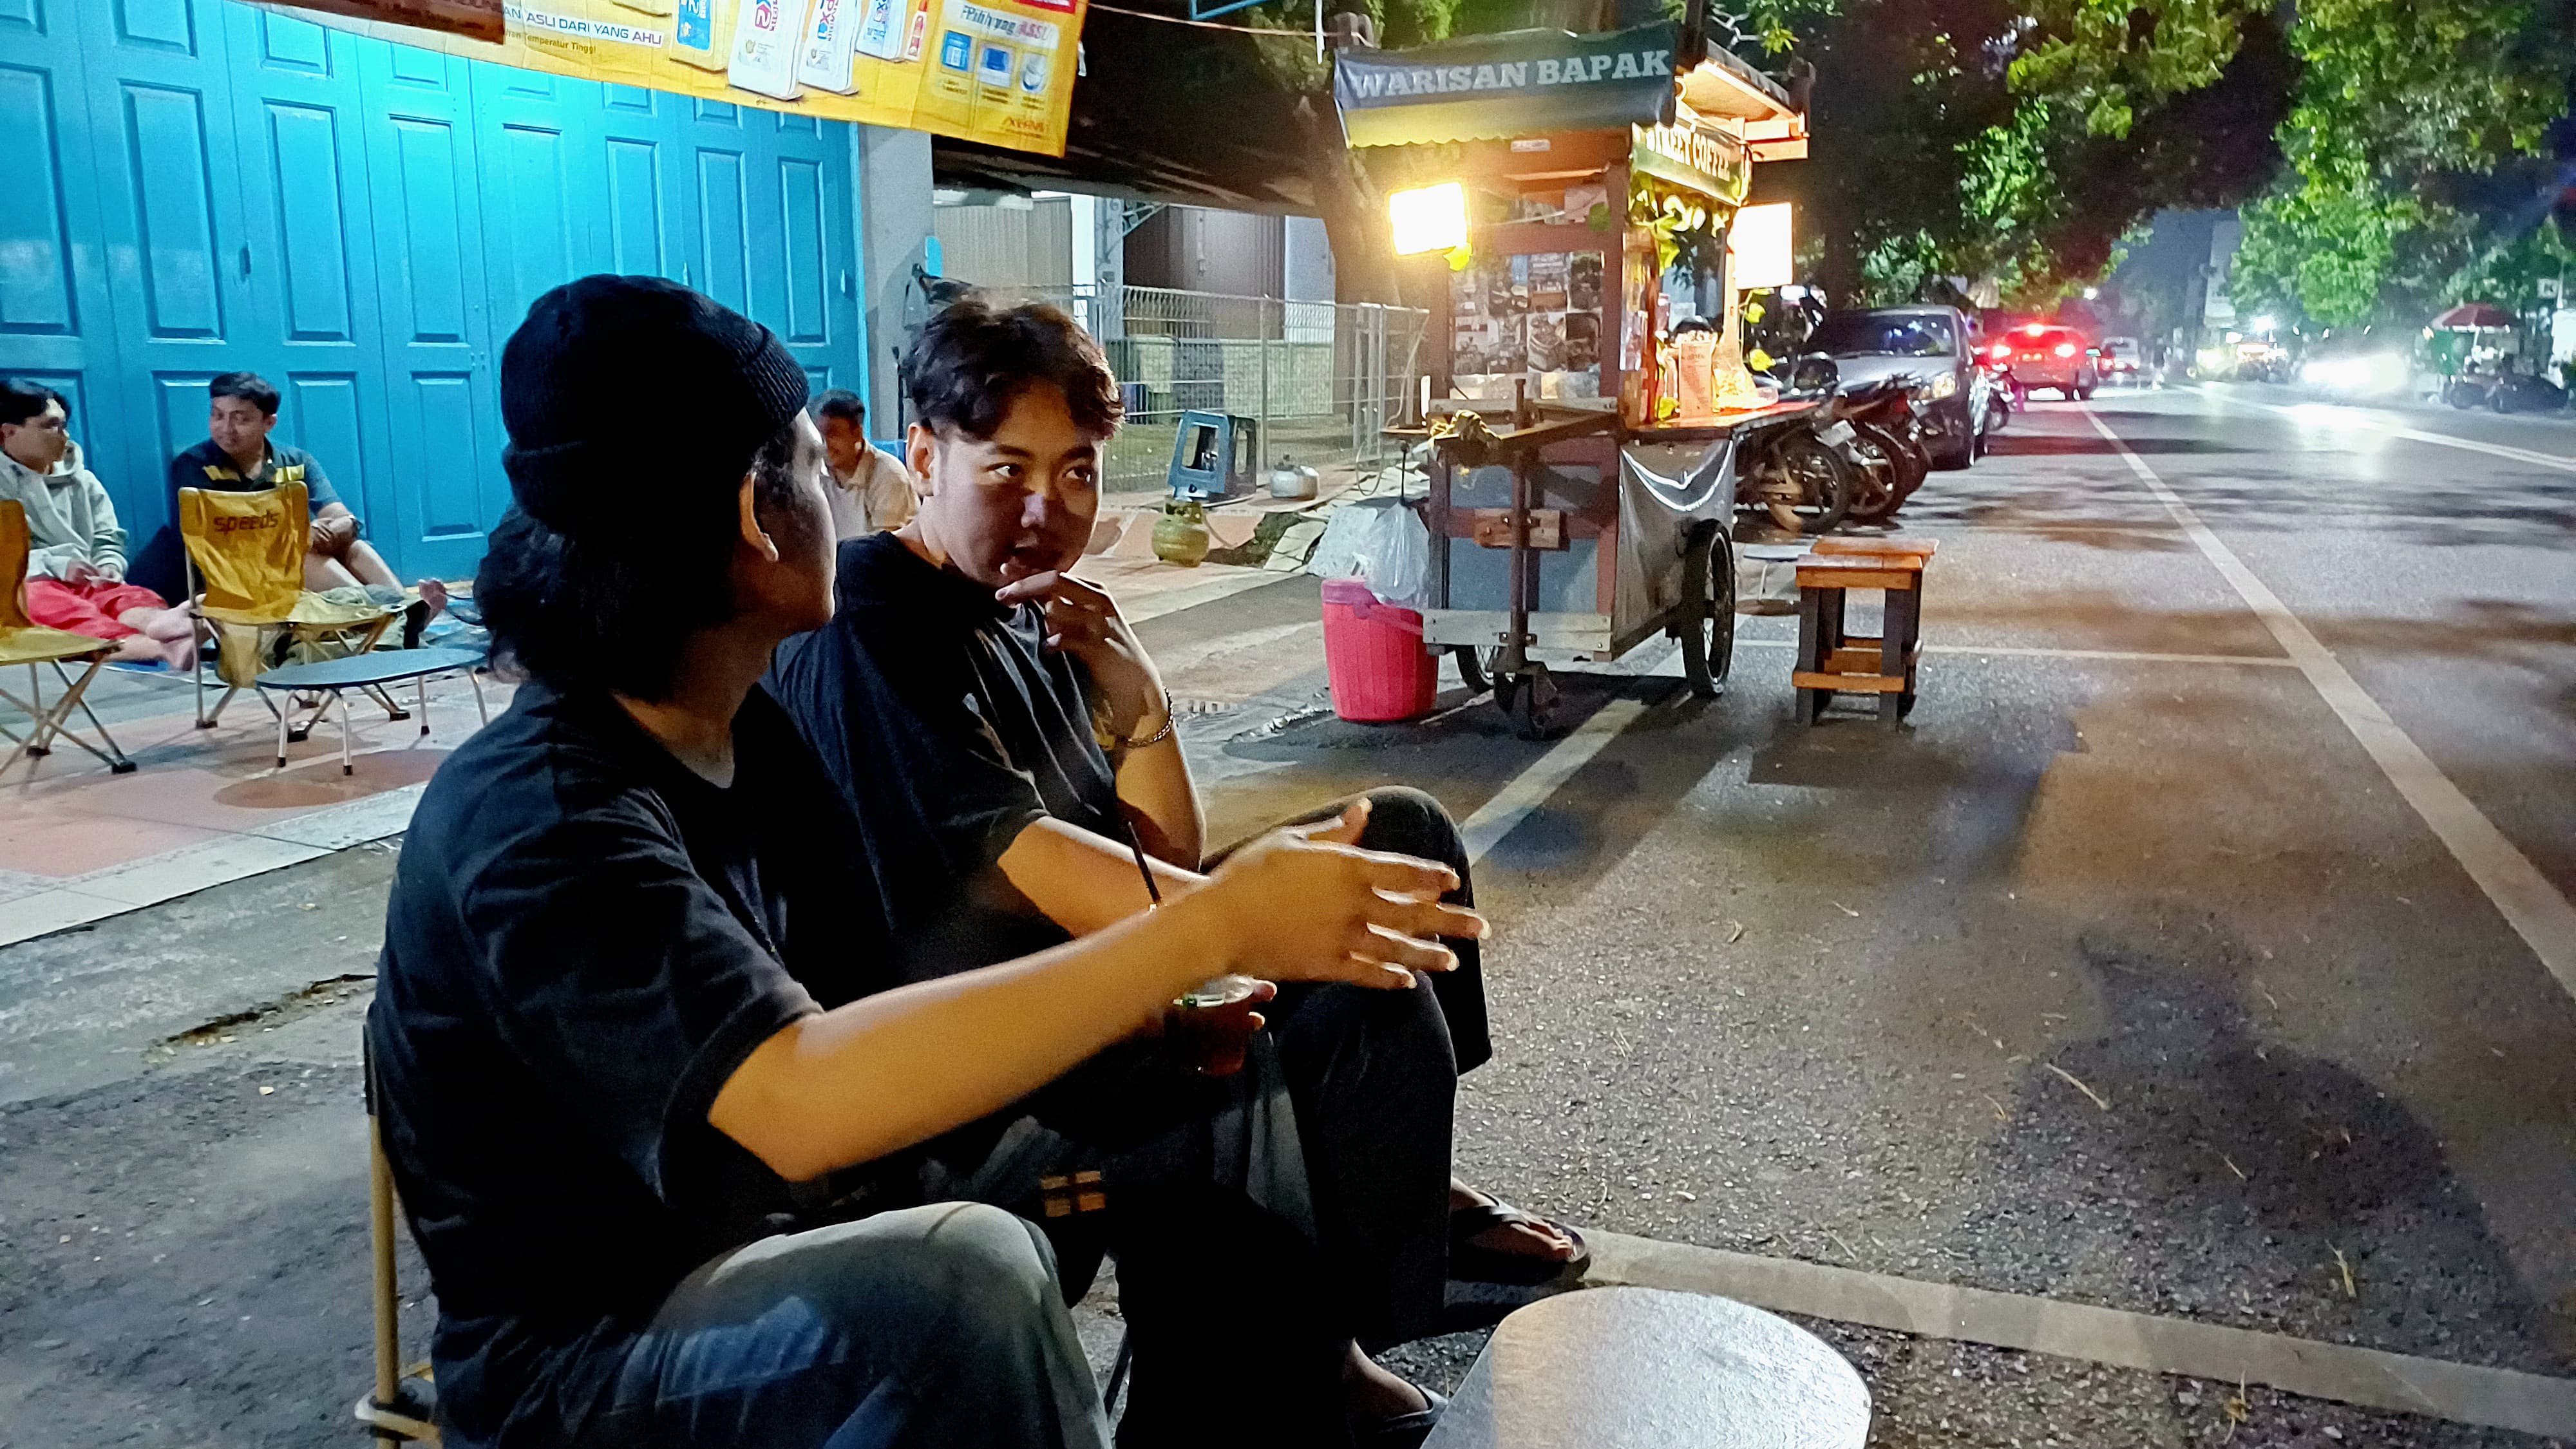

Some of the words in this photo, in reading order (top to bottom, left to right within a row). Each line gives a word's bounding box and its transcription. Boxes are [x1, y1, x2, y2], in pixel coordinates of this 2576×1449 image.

[503, 6, 522, 19] AN
[527, 12, 556, 28] ASLI
[559, 18, 590, 32] DARI
[594, 24, 629, 39] YANG
[632, 31, 662, 45] AHLI
[1352, 62, 1528, 99] WARISAN
[1537, 50, 1671, 86] BAPAK
[213, 509, 281, 536] speeds
